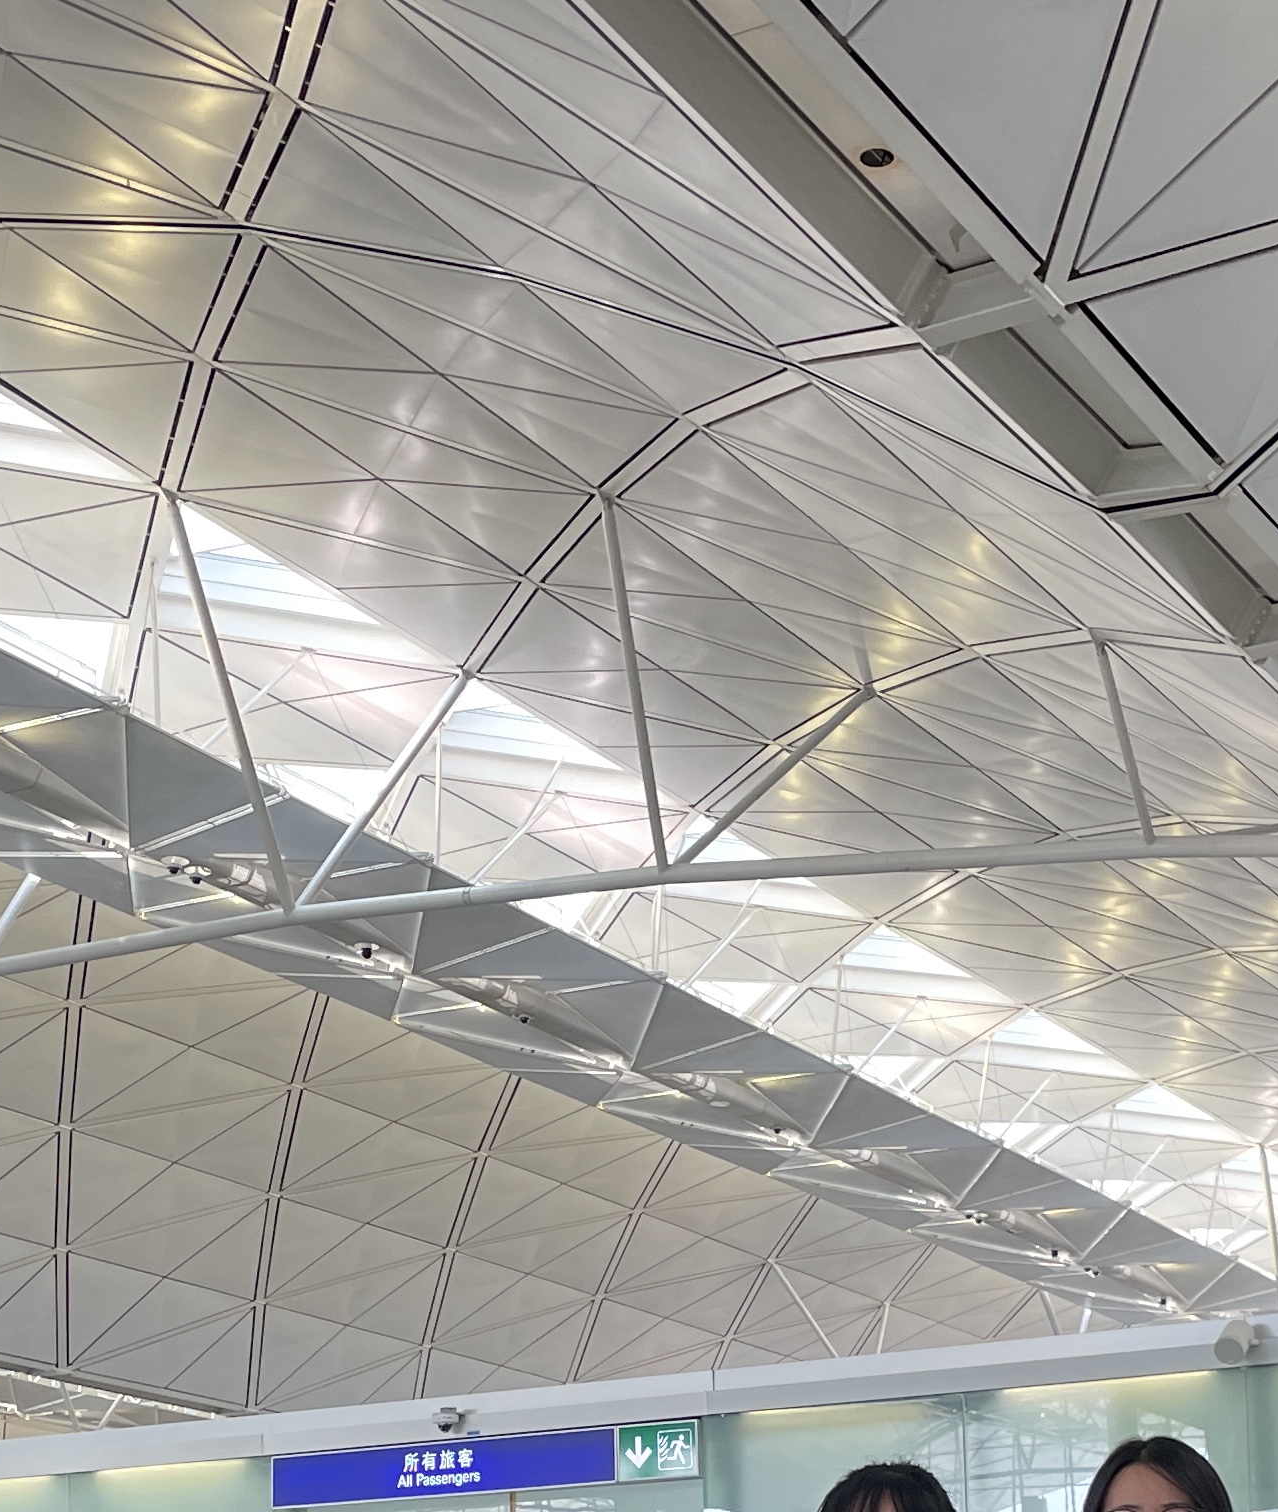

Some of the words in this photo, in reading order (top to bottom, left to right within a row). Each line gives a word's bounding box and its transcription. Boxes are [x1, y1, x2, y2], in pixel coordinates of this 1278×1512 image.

[403, 1448, 473, 1473] 所有旅客
[397, 1475, 413, 1489] All
[416, 1472, 481, 1487] Passengers
